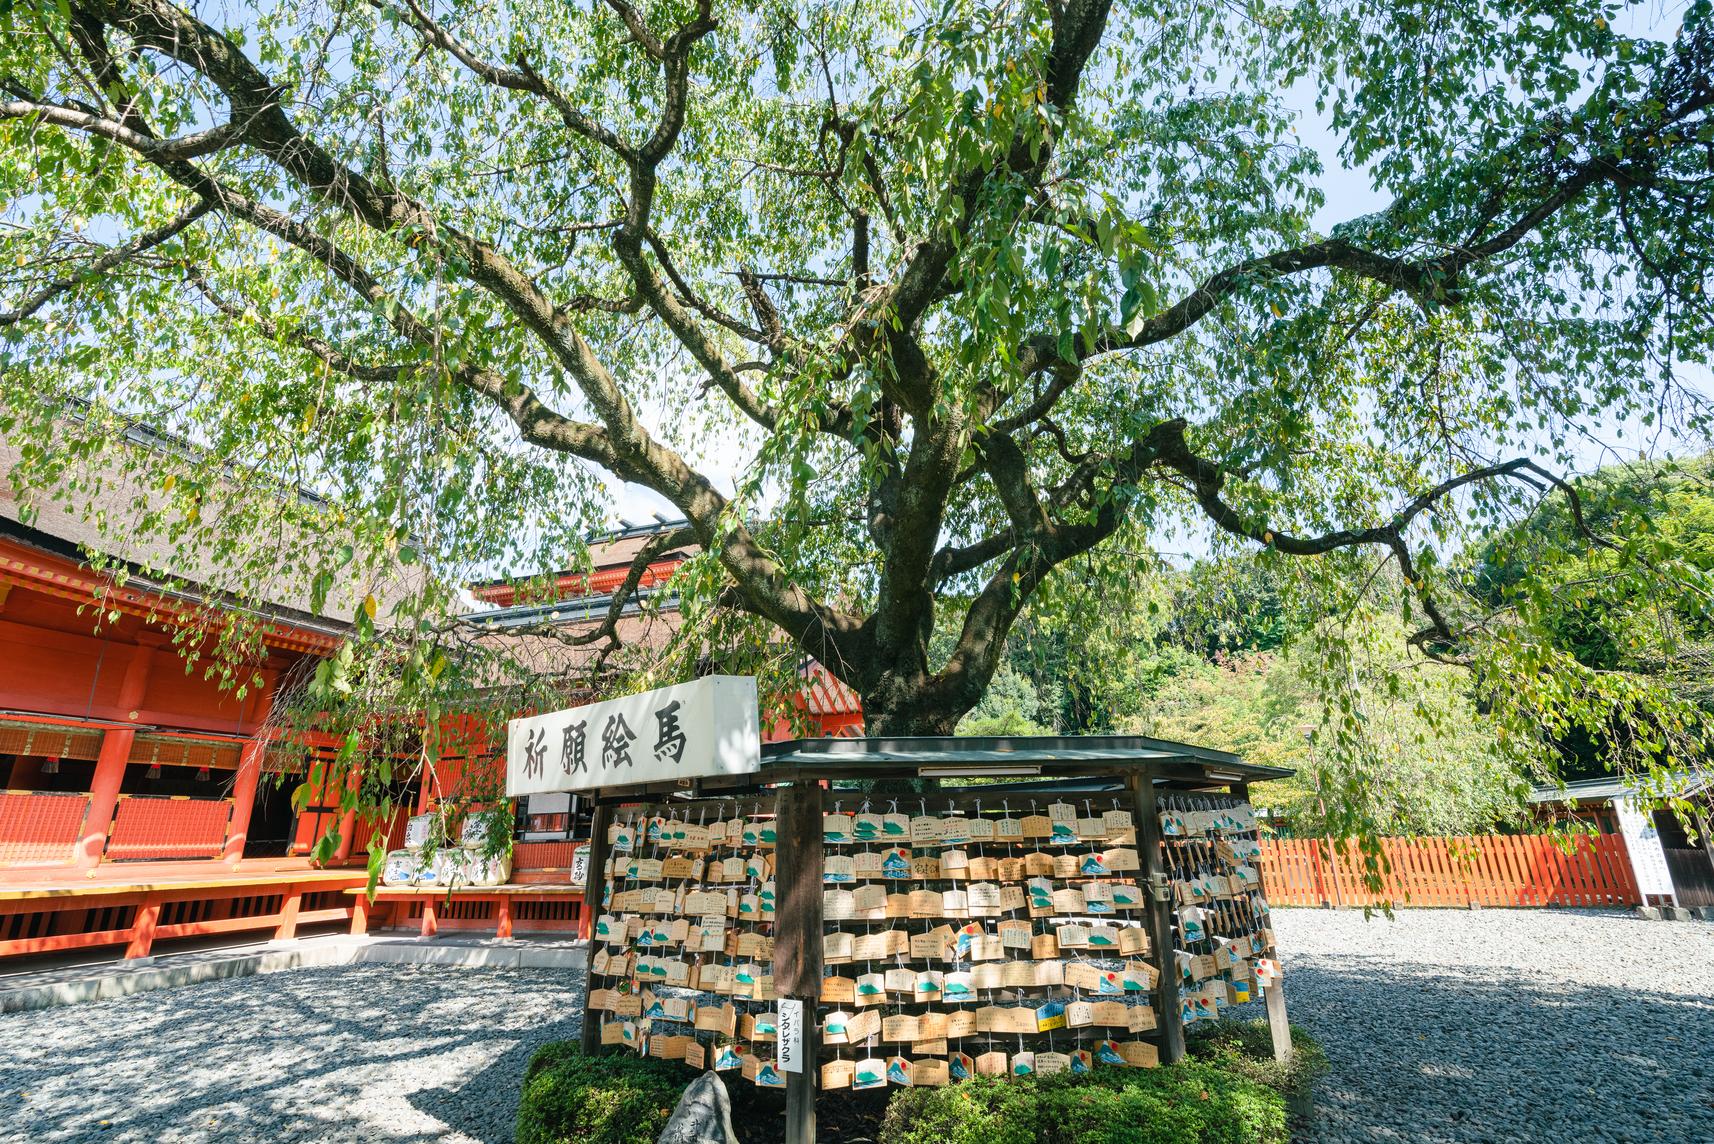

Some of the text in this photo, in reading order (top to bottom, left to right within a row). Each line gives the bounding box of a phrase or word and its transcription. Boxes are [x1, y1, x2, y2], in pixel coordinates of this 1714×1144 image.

[522, 700, 687, 781] 祈願絵馬
[781, 1012, 791, 1063] シダレザクラ
